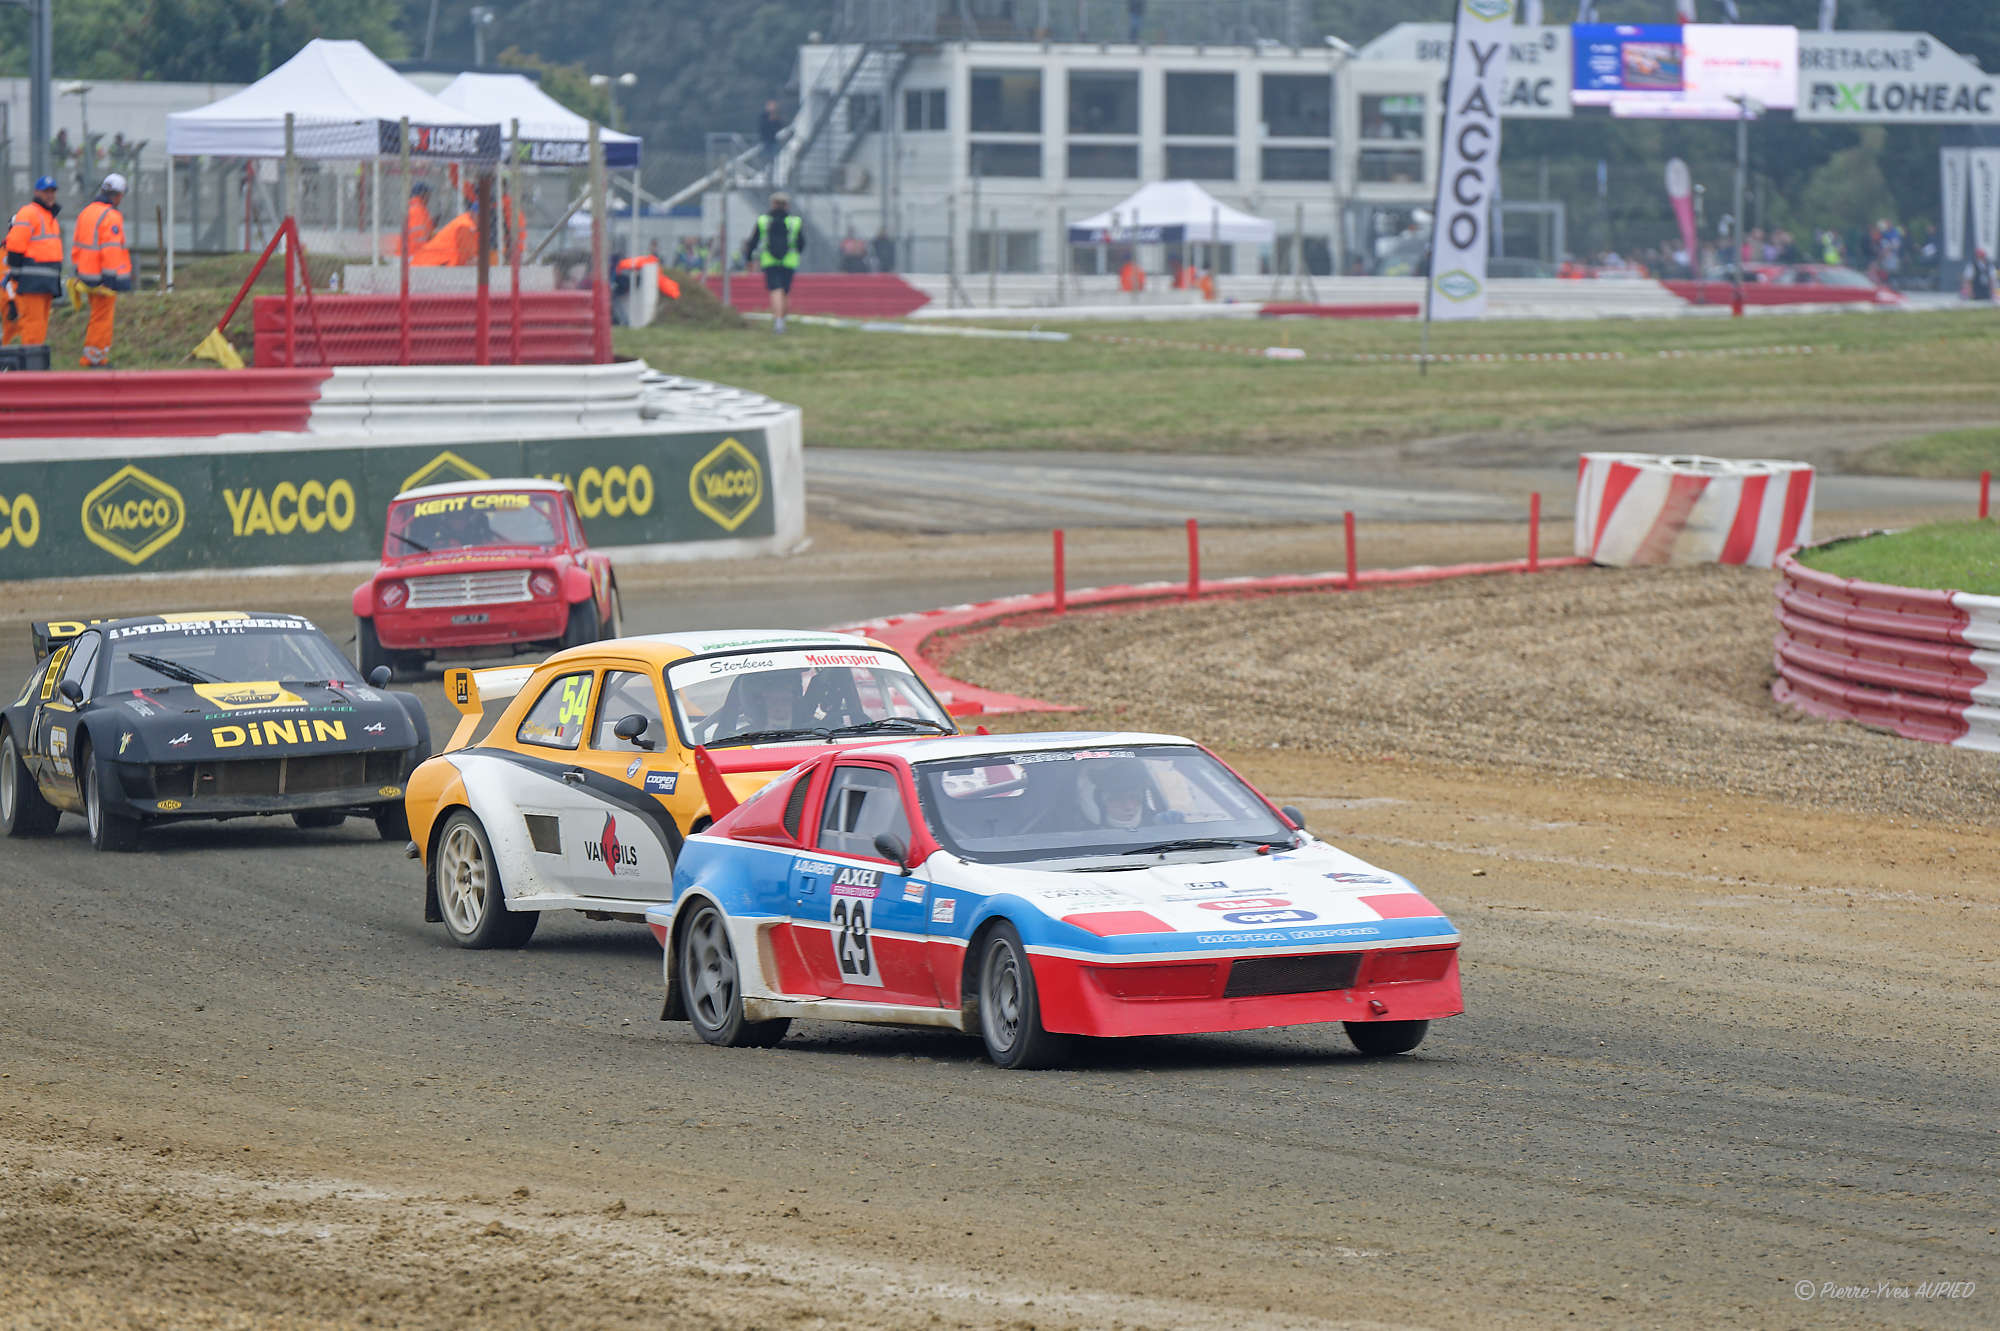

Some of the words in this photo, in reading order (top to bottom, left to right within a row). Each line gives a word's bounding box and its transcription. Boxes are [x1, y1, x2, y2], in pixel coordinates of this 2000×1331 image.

[1800, 48, 1914, 71] BRETAGNE
[1450, 40, 1500, 250] YACCO
[534, 464, 654, 518] CCO
[702, 468, 755, 498] YACCO
[97, 499, 171, 530] YACCO
[223, 478, 356, 537] YACCO
[414, 497, 467, 517] KENT
[471, 494, 530, 509] CAMS
[121, 621, 211, 637] LYDDEN
[184, 627, 246, 637] FESTIVAL
[709, 657, 775, 674] Sterkens
[804, 654, 880, 666] Motorsport
[559, 676, 592, 725] 54
[646, 775, 677, 785] COOPER
[584, 840, 609, 862] VAN
[611, 843, 638, 866] GILS
[836, 867, 878, 888] AXEL
[834, 898, 870, 977] 29
[1197, 932, 1287, 944] MATRA
